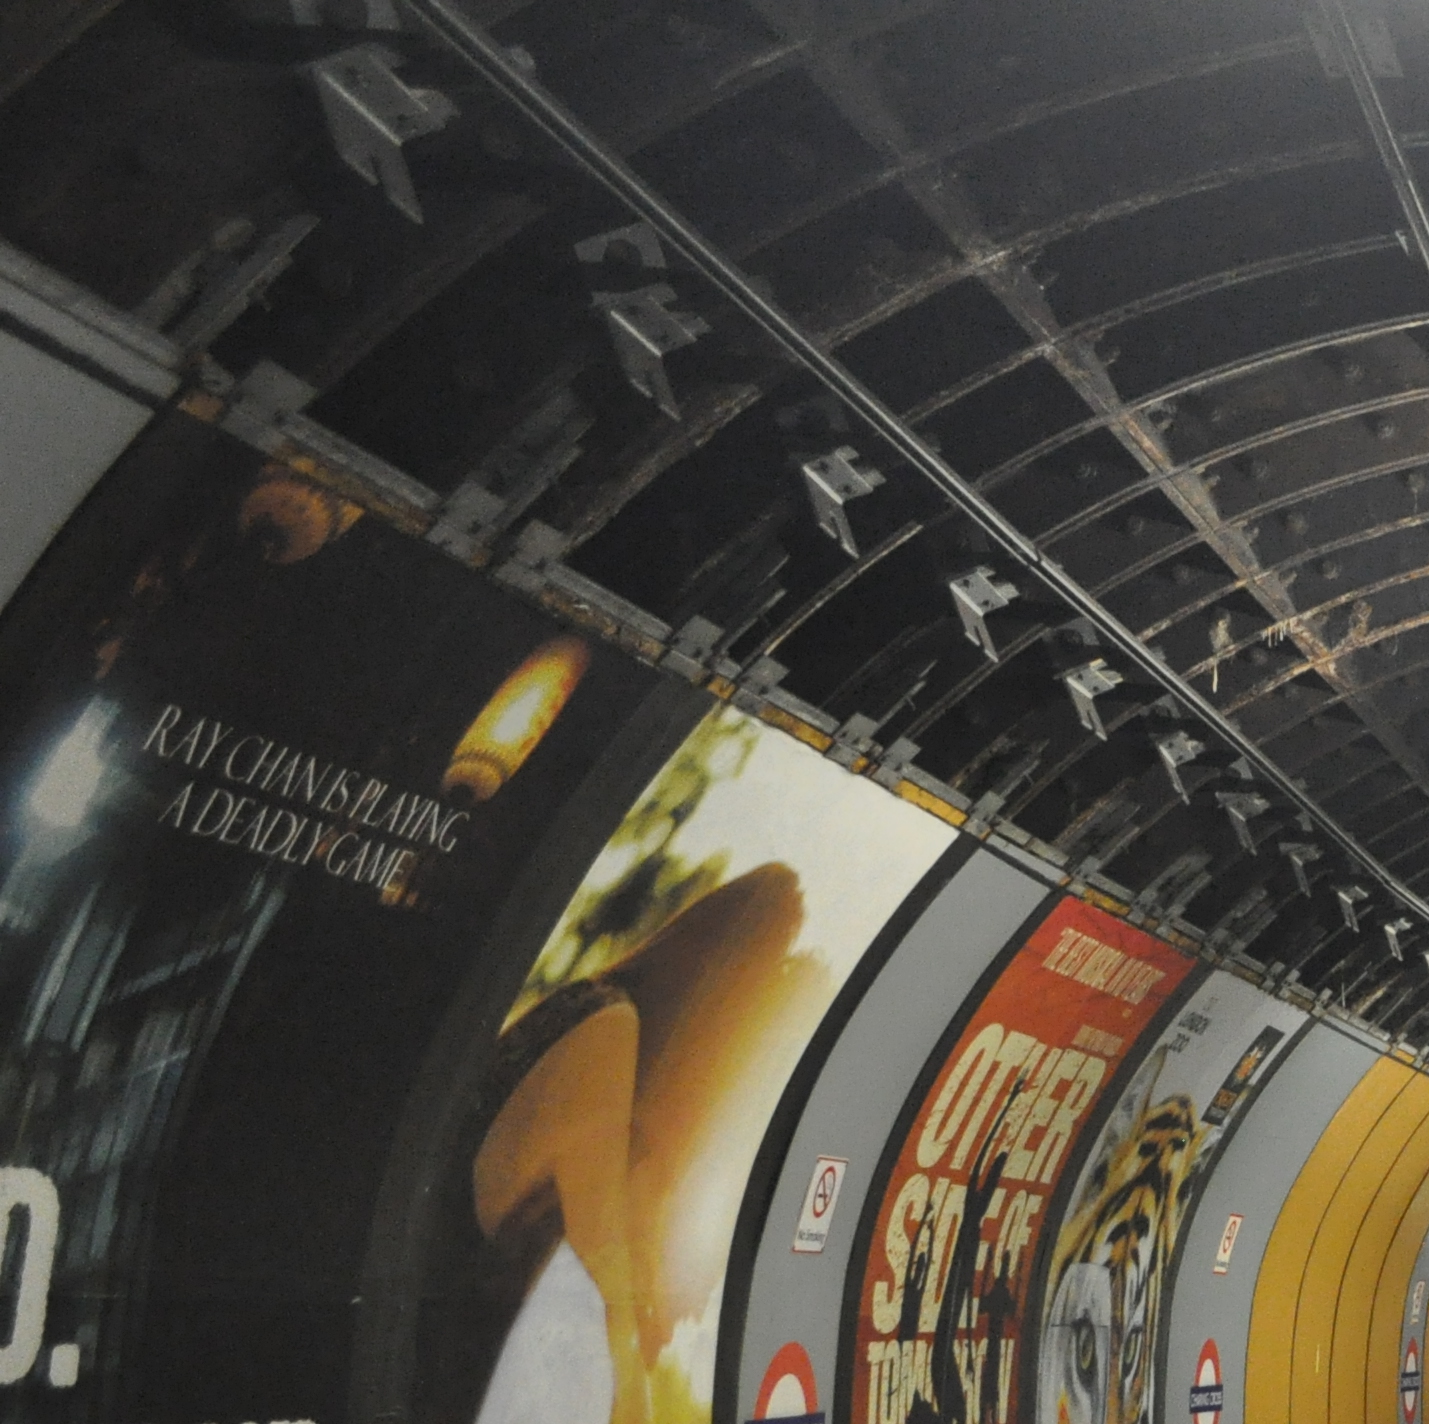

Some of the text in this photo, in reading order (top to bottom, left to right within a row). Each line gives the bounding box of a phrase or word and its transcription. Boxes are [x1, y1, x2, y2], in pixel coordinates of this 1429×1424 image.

[144, 704, 471, 852] RAY CHAN IS PLAYING
[158, 780, 416, 890] A DEADLY GAME
[916, 1023, 1107, 1184] OTHER
[872, 1173, 1044, 1334] SIDE OF
